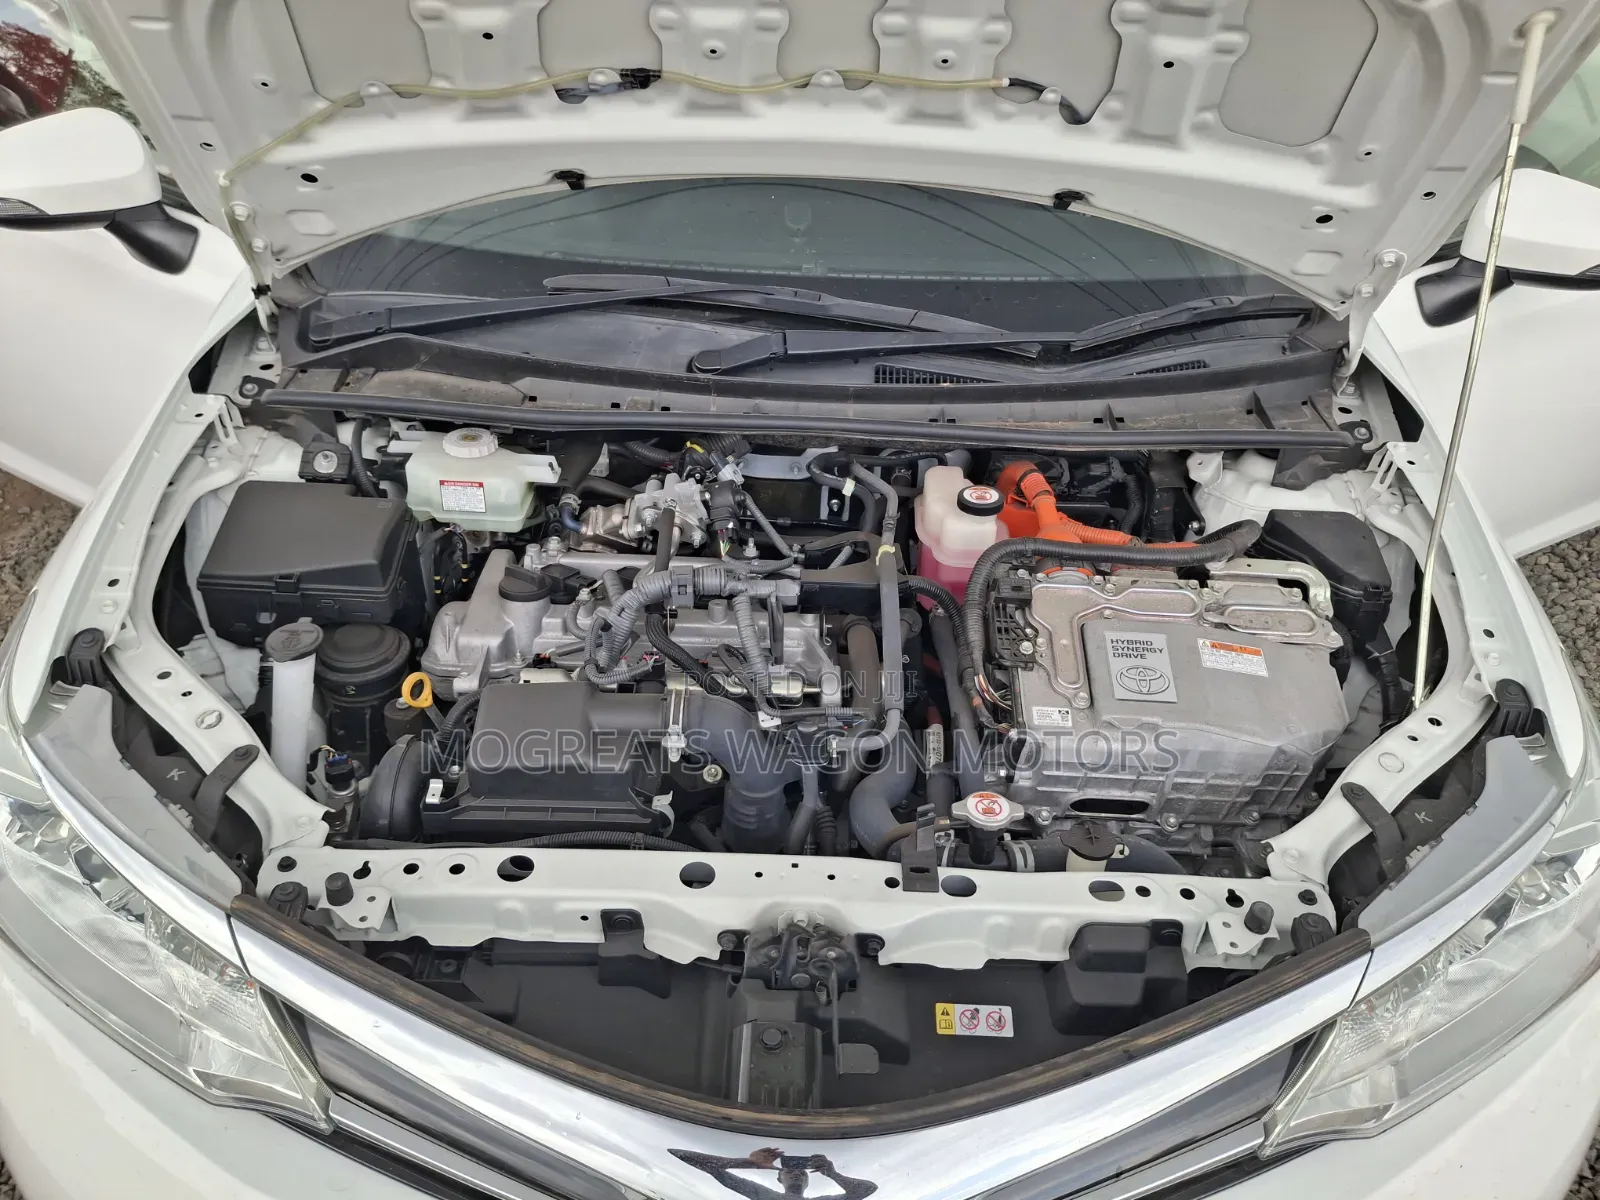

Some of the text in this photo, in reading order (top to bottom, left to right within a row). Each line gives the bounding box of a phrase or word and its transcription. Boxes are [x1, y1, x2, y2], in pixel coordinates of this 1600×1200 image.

[1110, 638, 1153, 647] HYBRID
[1111, 645, 1164, 654] SYNERGY
[1112, 652, 1147, 660] DRIVE
